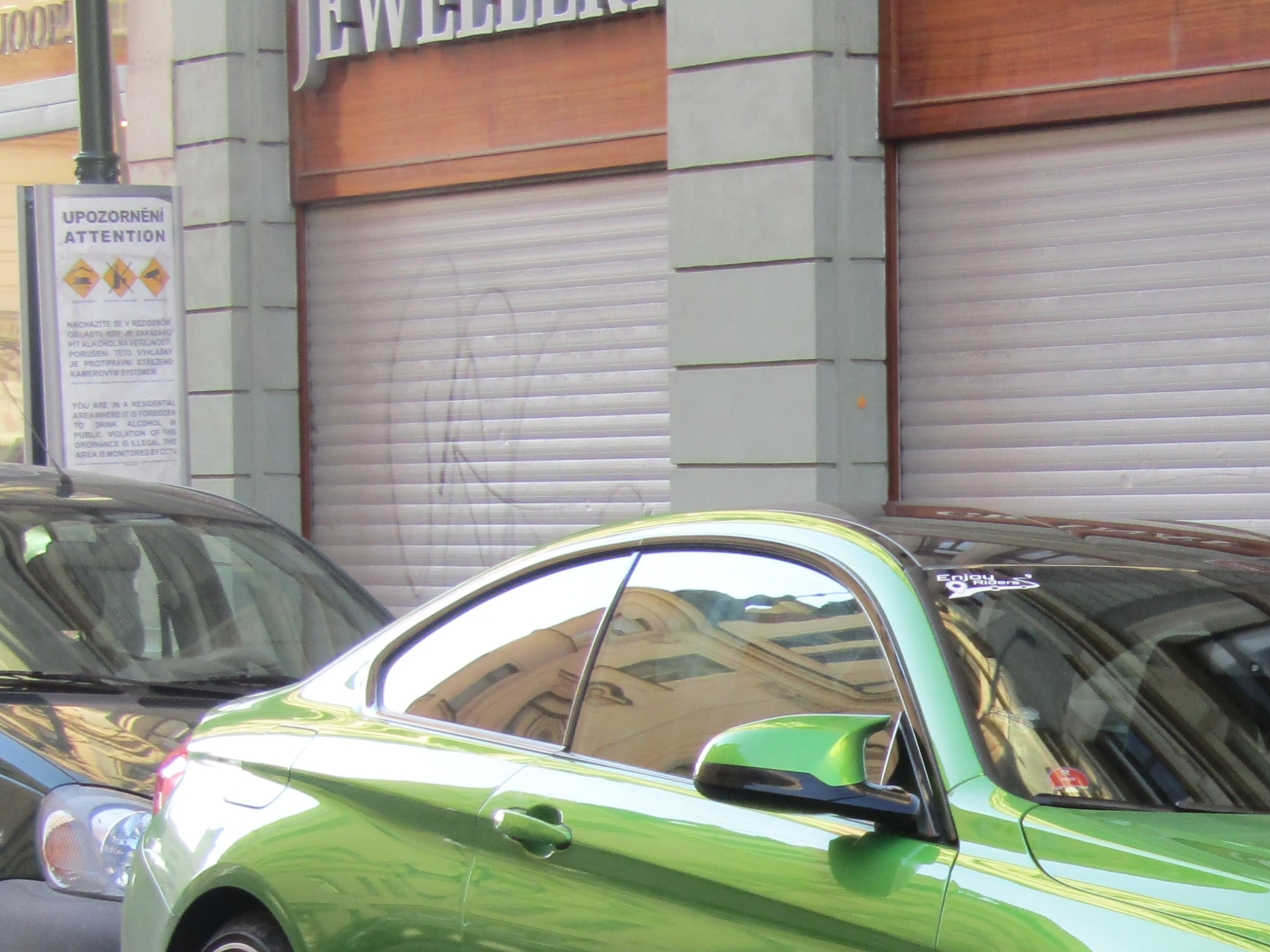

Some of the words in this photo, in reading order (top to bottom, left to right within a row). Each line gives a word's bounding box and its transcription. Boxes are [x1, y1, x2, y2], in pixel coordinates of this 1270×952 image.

[63, 207, 164, 224] UPOZORNĚNÍ
[64, 230, 165, 243] ATTENTION
[93, 401, 108, 409] ARE
[127, 419, 162, 427] ALCOHOL
[107, 429, 146, 437] VIOLATION
[75, 440, 119, 448] ORDINANCE
[75, 450, 97, 458] AREA
[106, 449, 150, 457] MONITORED
[936, 573, 995, 583] Enjoy
